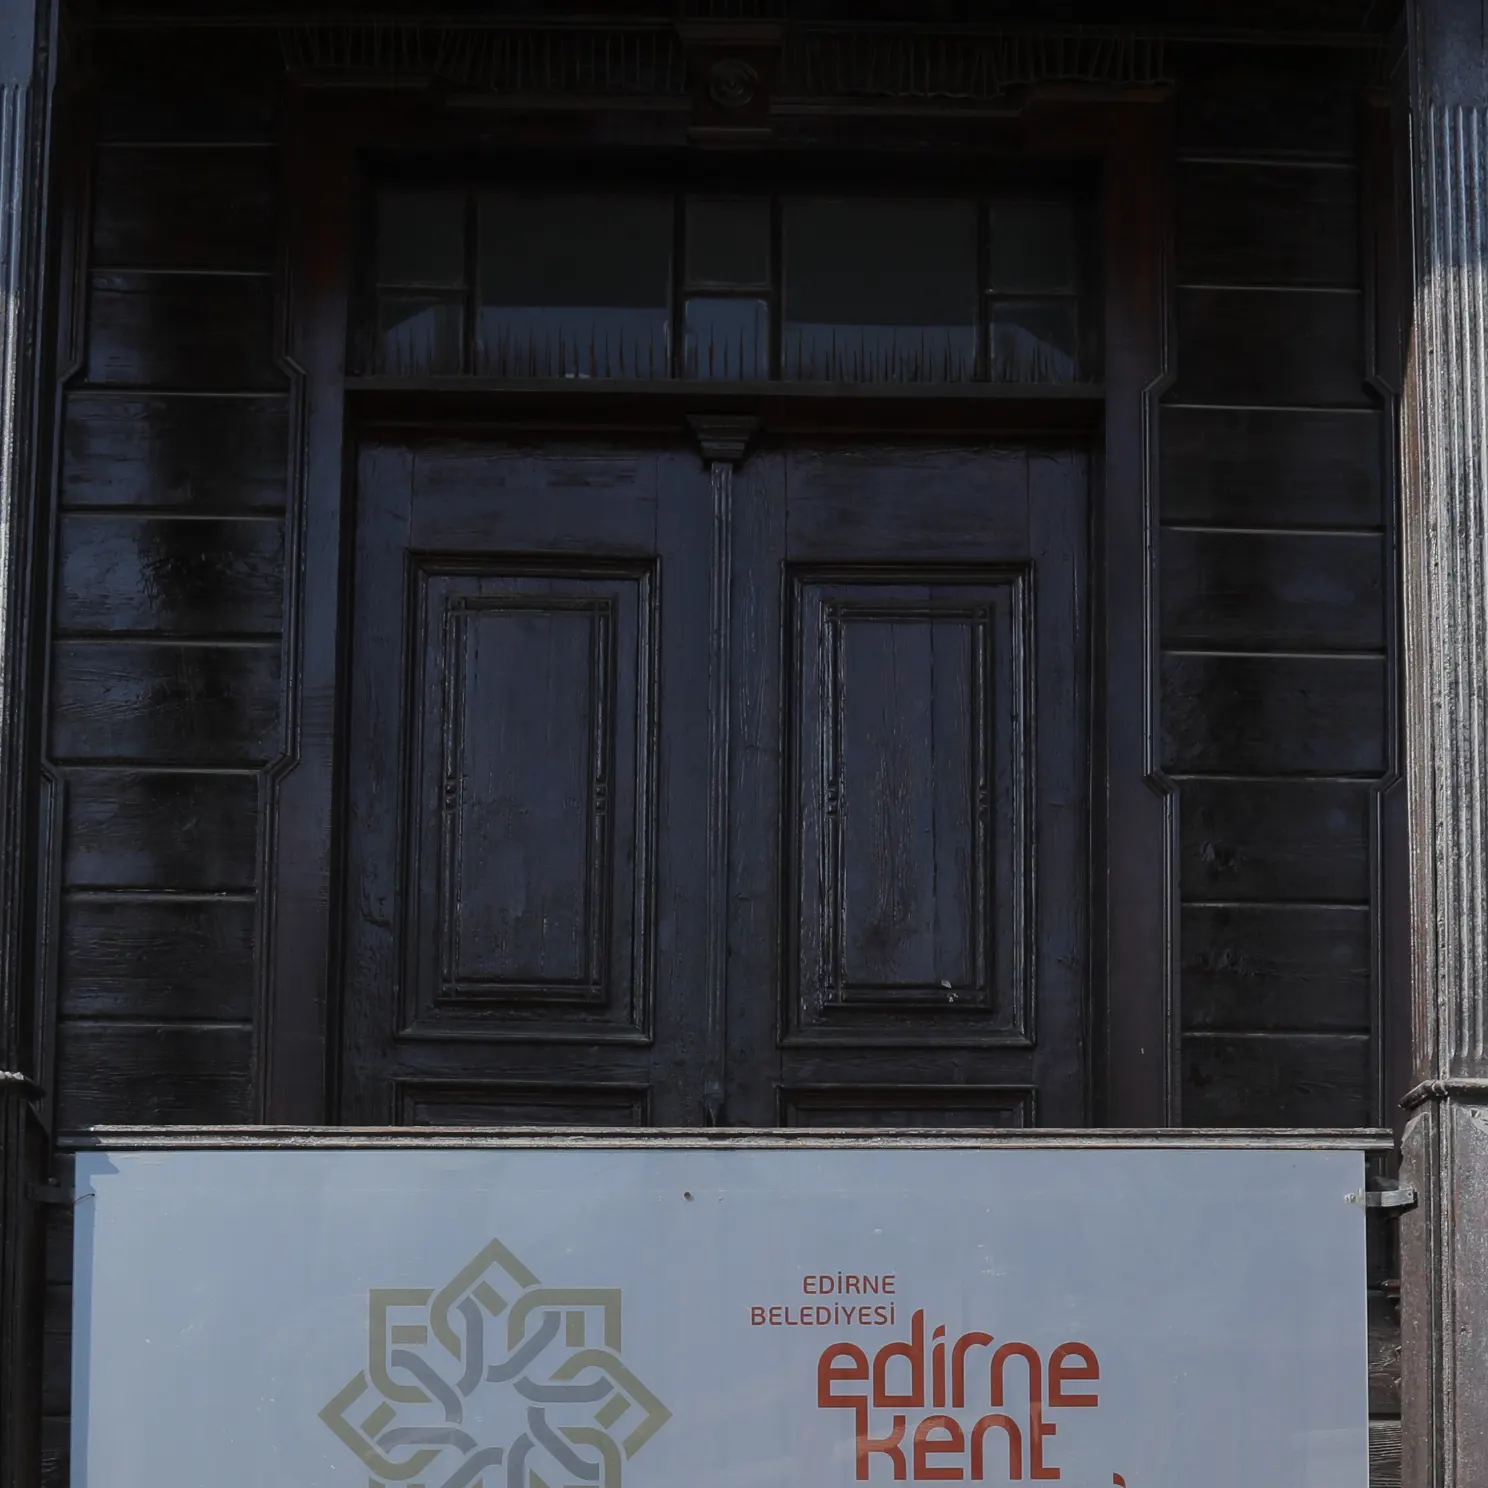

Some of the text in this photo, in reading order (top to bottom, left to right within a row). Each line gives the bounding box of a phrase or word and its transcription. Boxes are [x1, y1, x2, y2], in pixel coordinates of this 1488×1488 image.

[802, 1270, 897, 1295] EDİRNE
[750, 1301, 896, 1326] BELEDİYESİ
[855, 1402, 1061, 1481] kent
